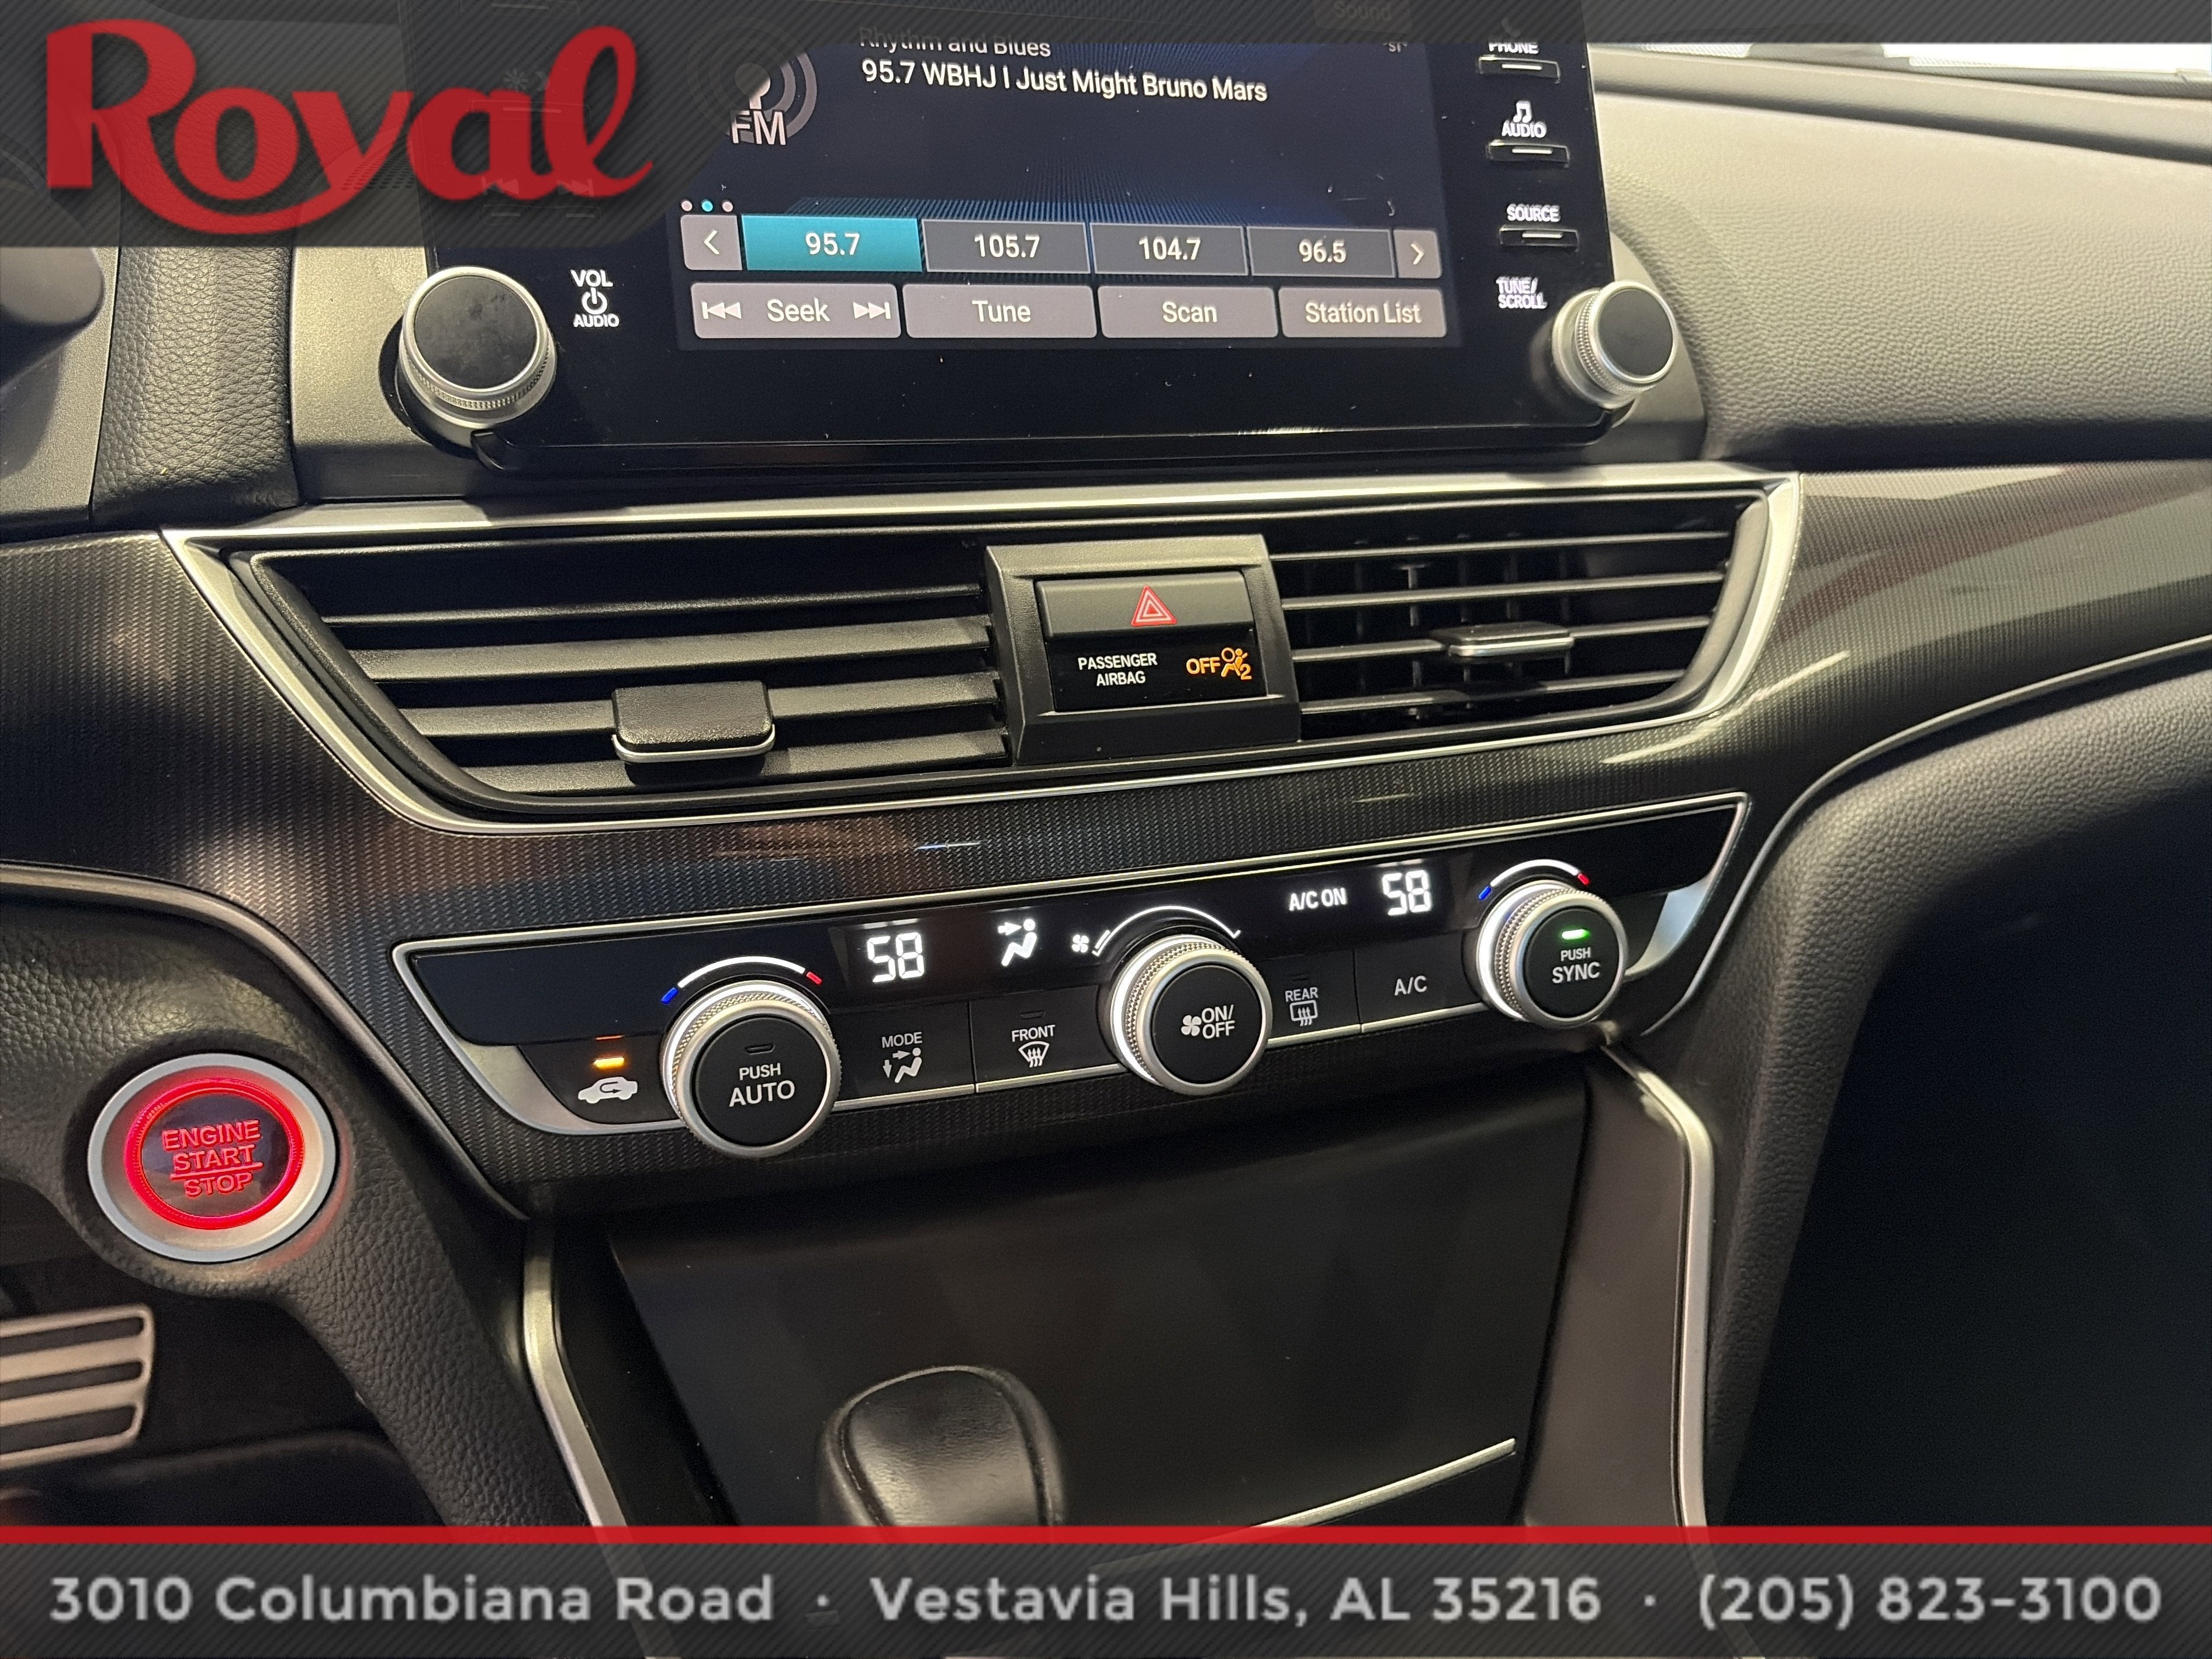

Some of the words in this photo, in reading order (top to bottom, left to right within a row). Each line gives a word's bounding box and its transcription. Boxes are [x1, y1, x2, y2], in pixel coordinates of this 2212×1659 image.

[859, 27, 943, 54] Rhythm
[948, 34, 988, 54] and
[992, 36, 1052, 57] Blues
[1487, 37, 1539, 54] PHONE
[861, 58, 915, 84] 95.7
[921, 60, 996, 88] WBHJ
[1016, 66, 1068, 92] Just
[1072, 68, 1138, 99] Might
[1142, 72, 1207, 98] Bruno
[1211, 75, 1268, 102] Mars
[731, 110, 787, 146] FM
[1502, 121, 1547, 139] AUDIO
[1506, 204, 1561, 223] SOURCE
[805, 232, 860, 256] 95.7
[974, 235, 1040, 258] 105.7
[1138, 238, 1201, 261] 104.7
[1299, 240, 1347, 263] 96.5
[570, 269, 613, 287] VOL
[1496, 276, 1537, 295] TUNE/
[767, 298, 831, 323] Seek
[972, 300, 1031, 323] Tune
[1161, 301, 1218, 324] Scan
[1305, 301, 1380, 324] Station
[1383, 301, 1423, 324] List
[1498, 294, 1547, 309] SCROLL
[573, 314, 620, 328] AUDIO
[1077, 652, 1158, 671] PASSENGER
[1186, 657, 1221, 675] OFF
[1096, 670, 1146, 687] AIRBAG
[1288, 890, 1319, 911] A/C
[1320, 887, 1348, 907] ON
[1383, 868, 1432, 917] 58
[866, 932, 926, 984] 58
[1560, 946, 1591, 963] PUSH
[1551, 961, 1600, 984] SYNC
[1285, 986, 1319, 1002] REAR
[1393, 975, 1427, 996] A/C
[1200, 1003, 1235, 1022] ON/
[881, 1031, 923, 1048] MODE
[1011, 1024, 1056, 1043] FRONT
[1201, 1021, 1235, 1040] OFF
[738, 1062, 782, 1081] PUSH
[729, 1080, 795, 1108] AUTO
[162, 1119, 261, 1150] ENGINE
[173, 1144, 255, 1172] START
[184, 1172, 253, 1197] STOP
